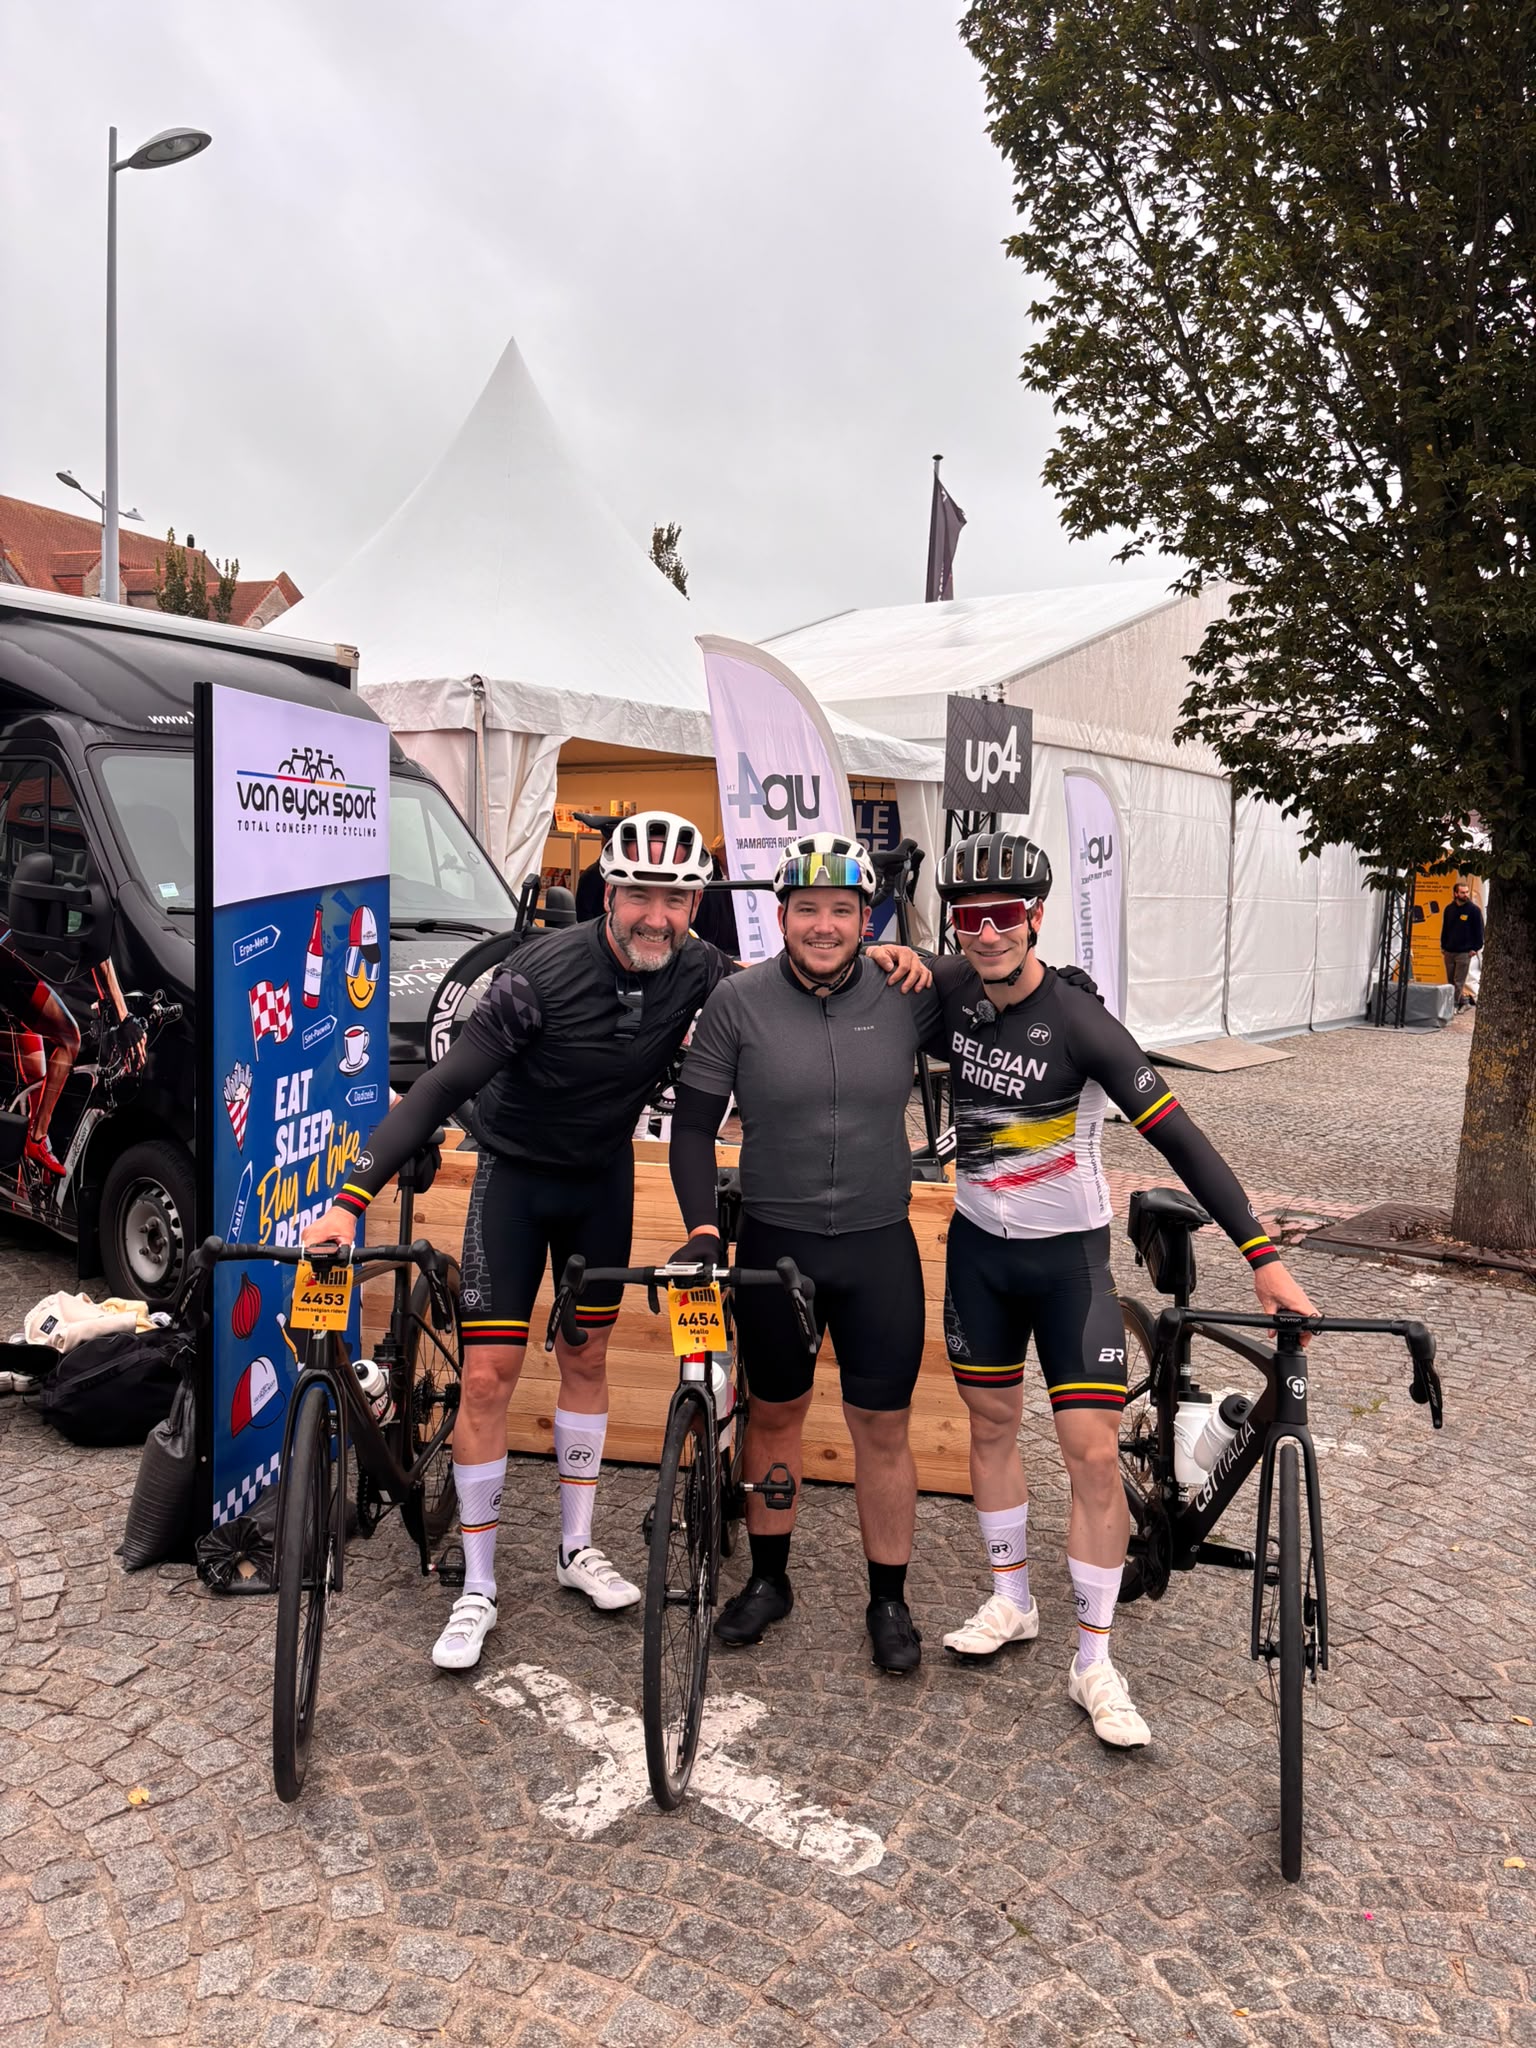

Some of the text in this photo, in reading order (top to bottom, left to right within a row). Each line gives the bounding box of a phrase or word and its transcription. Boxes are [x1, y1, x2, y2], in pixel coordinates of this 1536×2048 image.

[965, 725, 1022, 793] up4
[236, 781, 377, 824] van eyck sport
[237, 819, 377, 838] TOTAL CONCEPT FOR CYCLING
[239, 936, 269, 957] Erpe-Mere
[389, 973, 428, 987] an
[389, 987, 424, 997] OTAL
[952, 1031, 1048, 1081] BELGIAN
[274, 1068, 313, 1122] EAT
[961, 1060, 1026, 1100] RIDER
[275, 1109, 333, 1169] SLEEP
[256, 1120, 361, 1245] Buy a bike
[231, 1199, 246, 1238] Aalst
[301, 1292, 344, 1306] 4453
[678, 1312, 720, 1327] 4454
[1098, 1348, 1124, 1363] BR
[569, 1449, 594, 1462] BR
[1218, 1419, 1256, 1480] ITALIA
[992, 1543, 1008, 1554] BR
